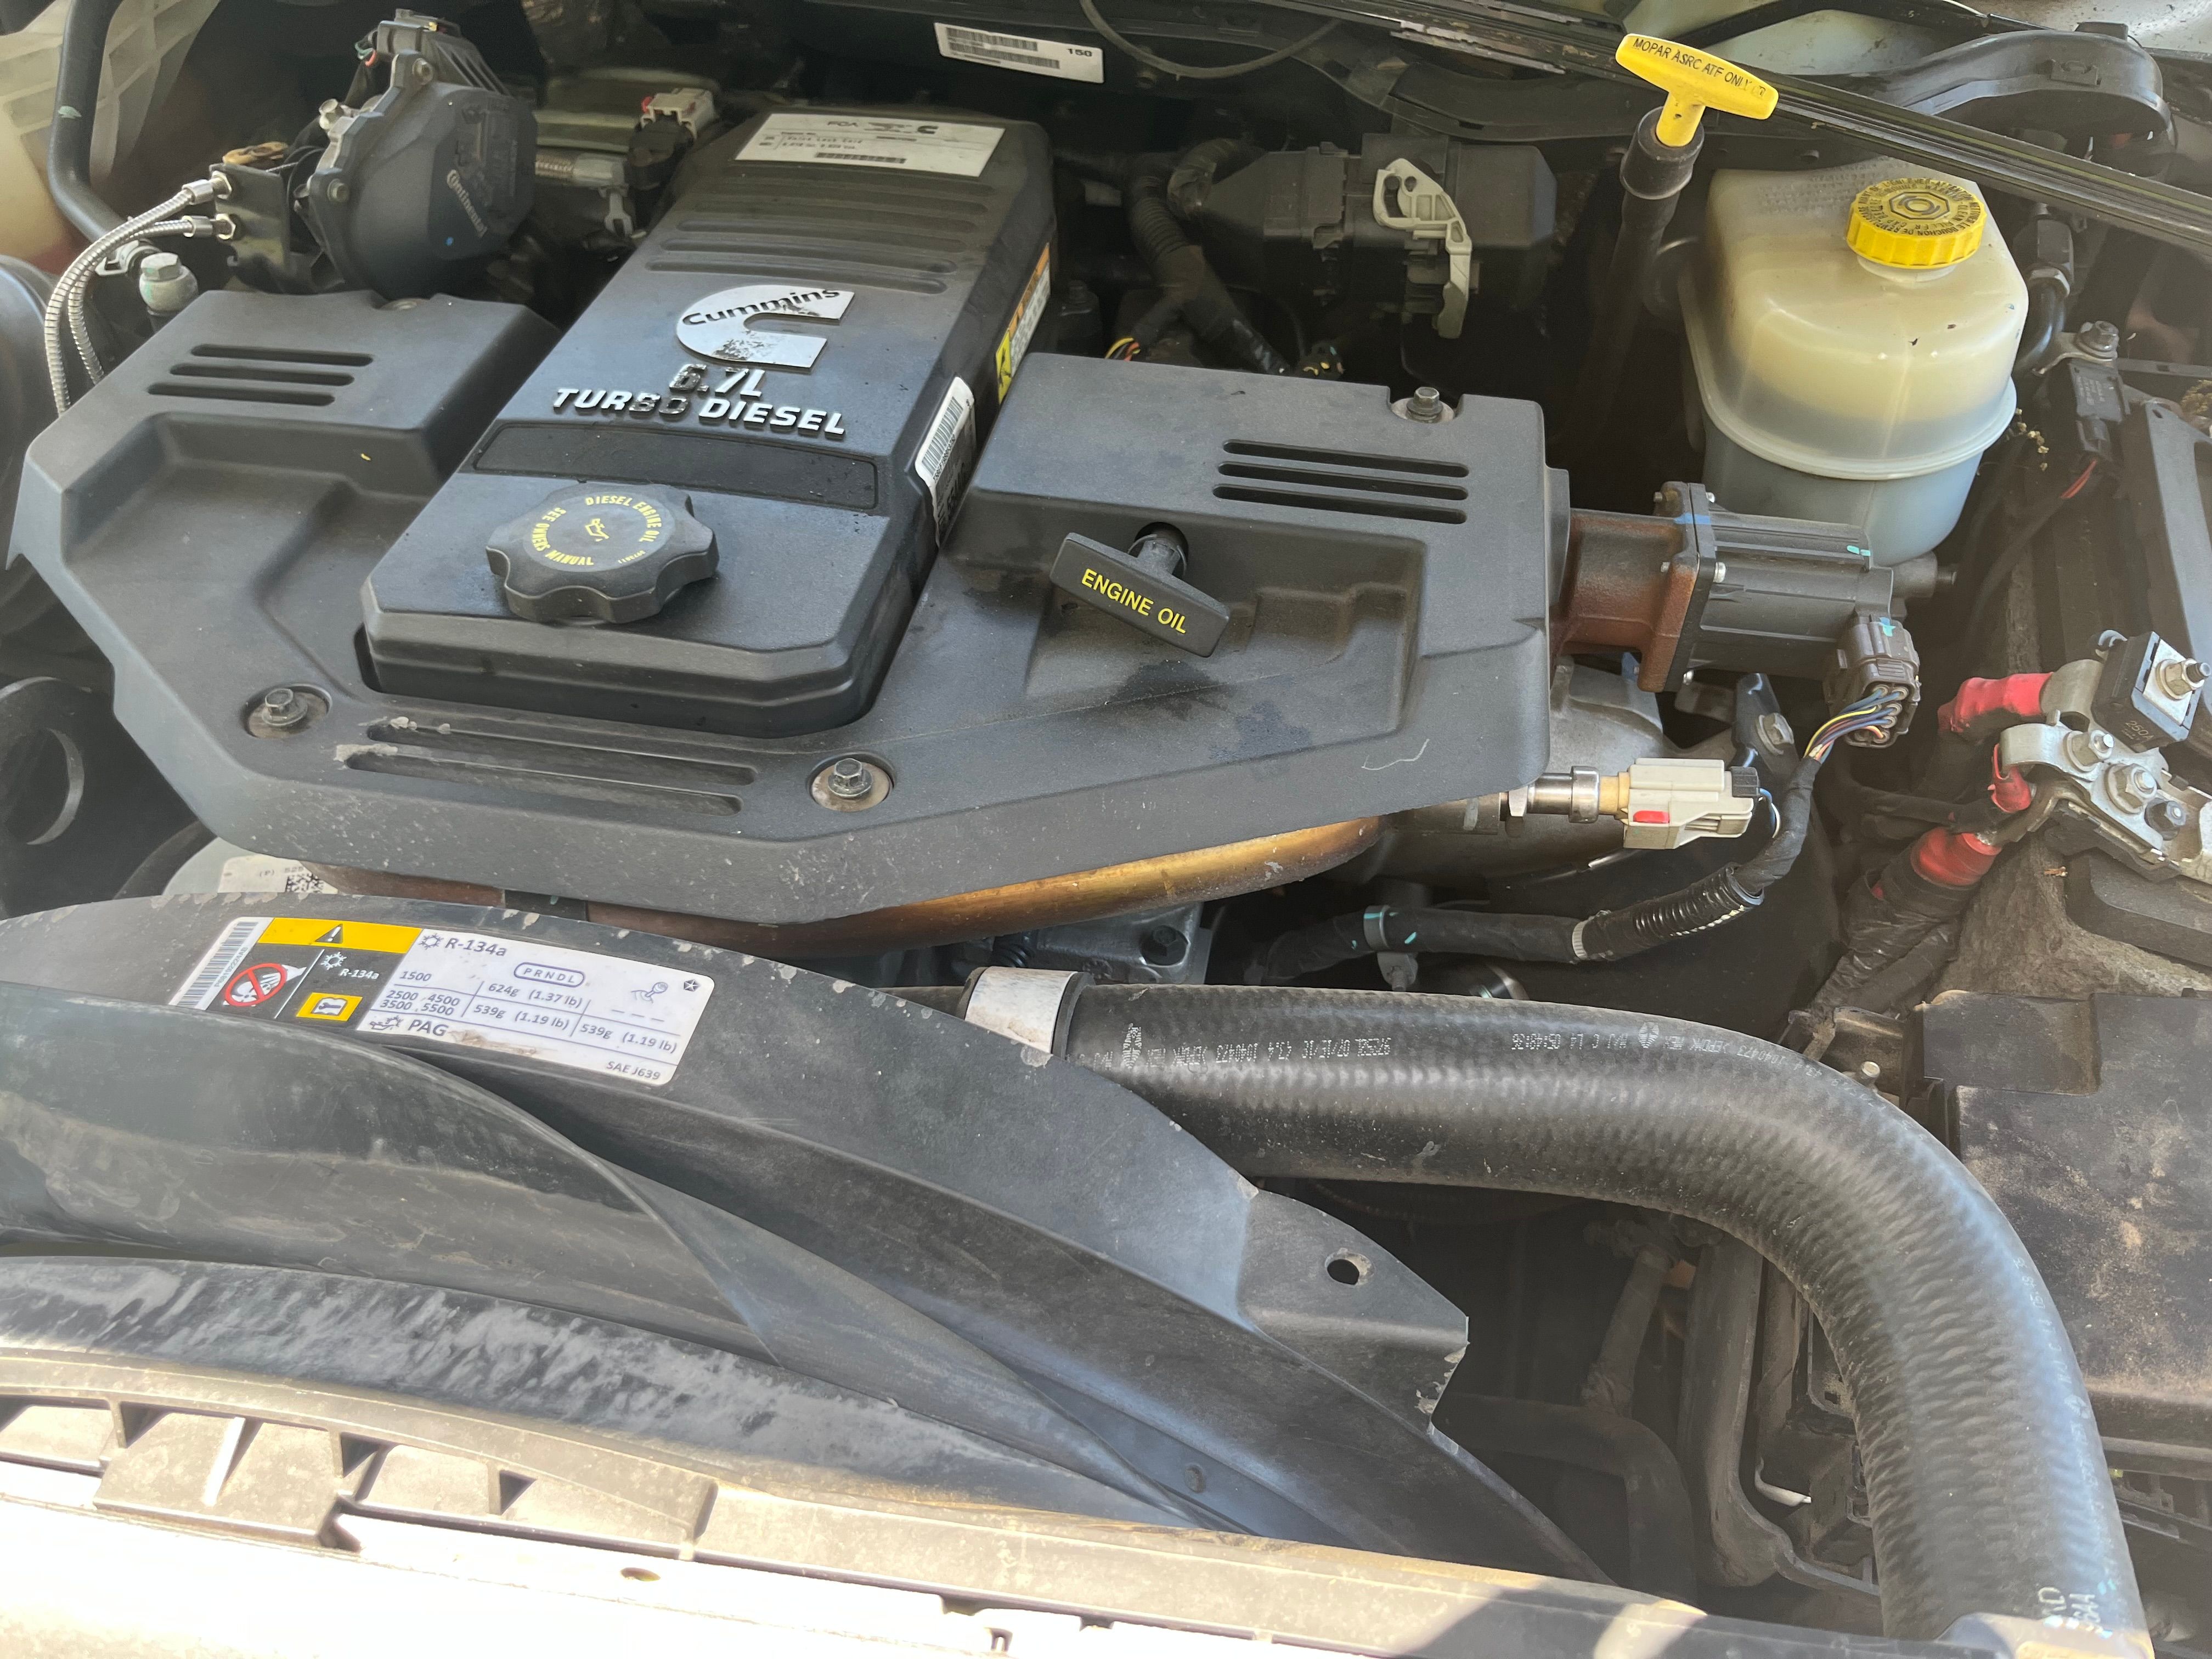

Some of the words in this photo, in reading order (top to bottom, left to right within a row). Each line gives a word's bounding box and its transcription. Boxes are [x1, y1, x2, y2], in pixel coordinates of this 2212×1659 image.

[1633, 38, 1672, 59] MOPAR
[1671, 49, 1702, 70] ASRC
[1702, 63, 1725, 77] ATF
[682, 288, 840, 326] Cummins
[668, 363, 766, 398] 6.7L
[553, 388, 690, 415] TURBO
[698, 397, 845, 436] DIESEL
[585, 495, 633, 506] DIESEL
[541, 507, 567, 522] SEE
[633, 501, 662, 529] ENGINE
[639, 530, 660, 542] OIL
[545, 550, 594, 566] MANUAL
[1081, 568, 1154, 616] ENGINE
[1157, 607, 1186, 634] OIL
[2125, 720, 2154, 741] 250A
[445, 938, 507, 956] R-134a
[340, 968, 380, 980] R-134a
[386, 990, 419, 1001] 2500
[427, 993, 461, 1007] 4500
[399, 970, 432, 982] 1500
[488, 982, 521, 997] 624g
[528, 989, 563, 1003] (1.37
[563, 995, 584, 1009] lb)
[380, 999, 413, 1011] 3500
[421, 1003, 455, 1016] 5500
[473, 1004, 507, 1019] 539g
[515, 1011, 549, 1026] (1.19
[549, 1017, 571, 1031] lb)
[408, 1019, 449, 1036] PAG
[580, 1023, 613, 1040] 539g
[622, 1031, 656, 1048] (1.19
[657, 1040, 678, 1054] lb)
[606, 1060, 630, 1074] SAE
[631, 1066, 661, 1081] J639
